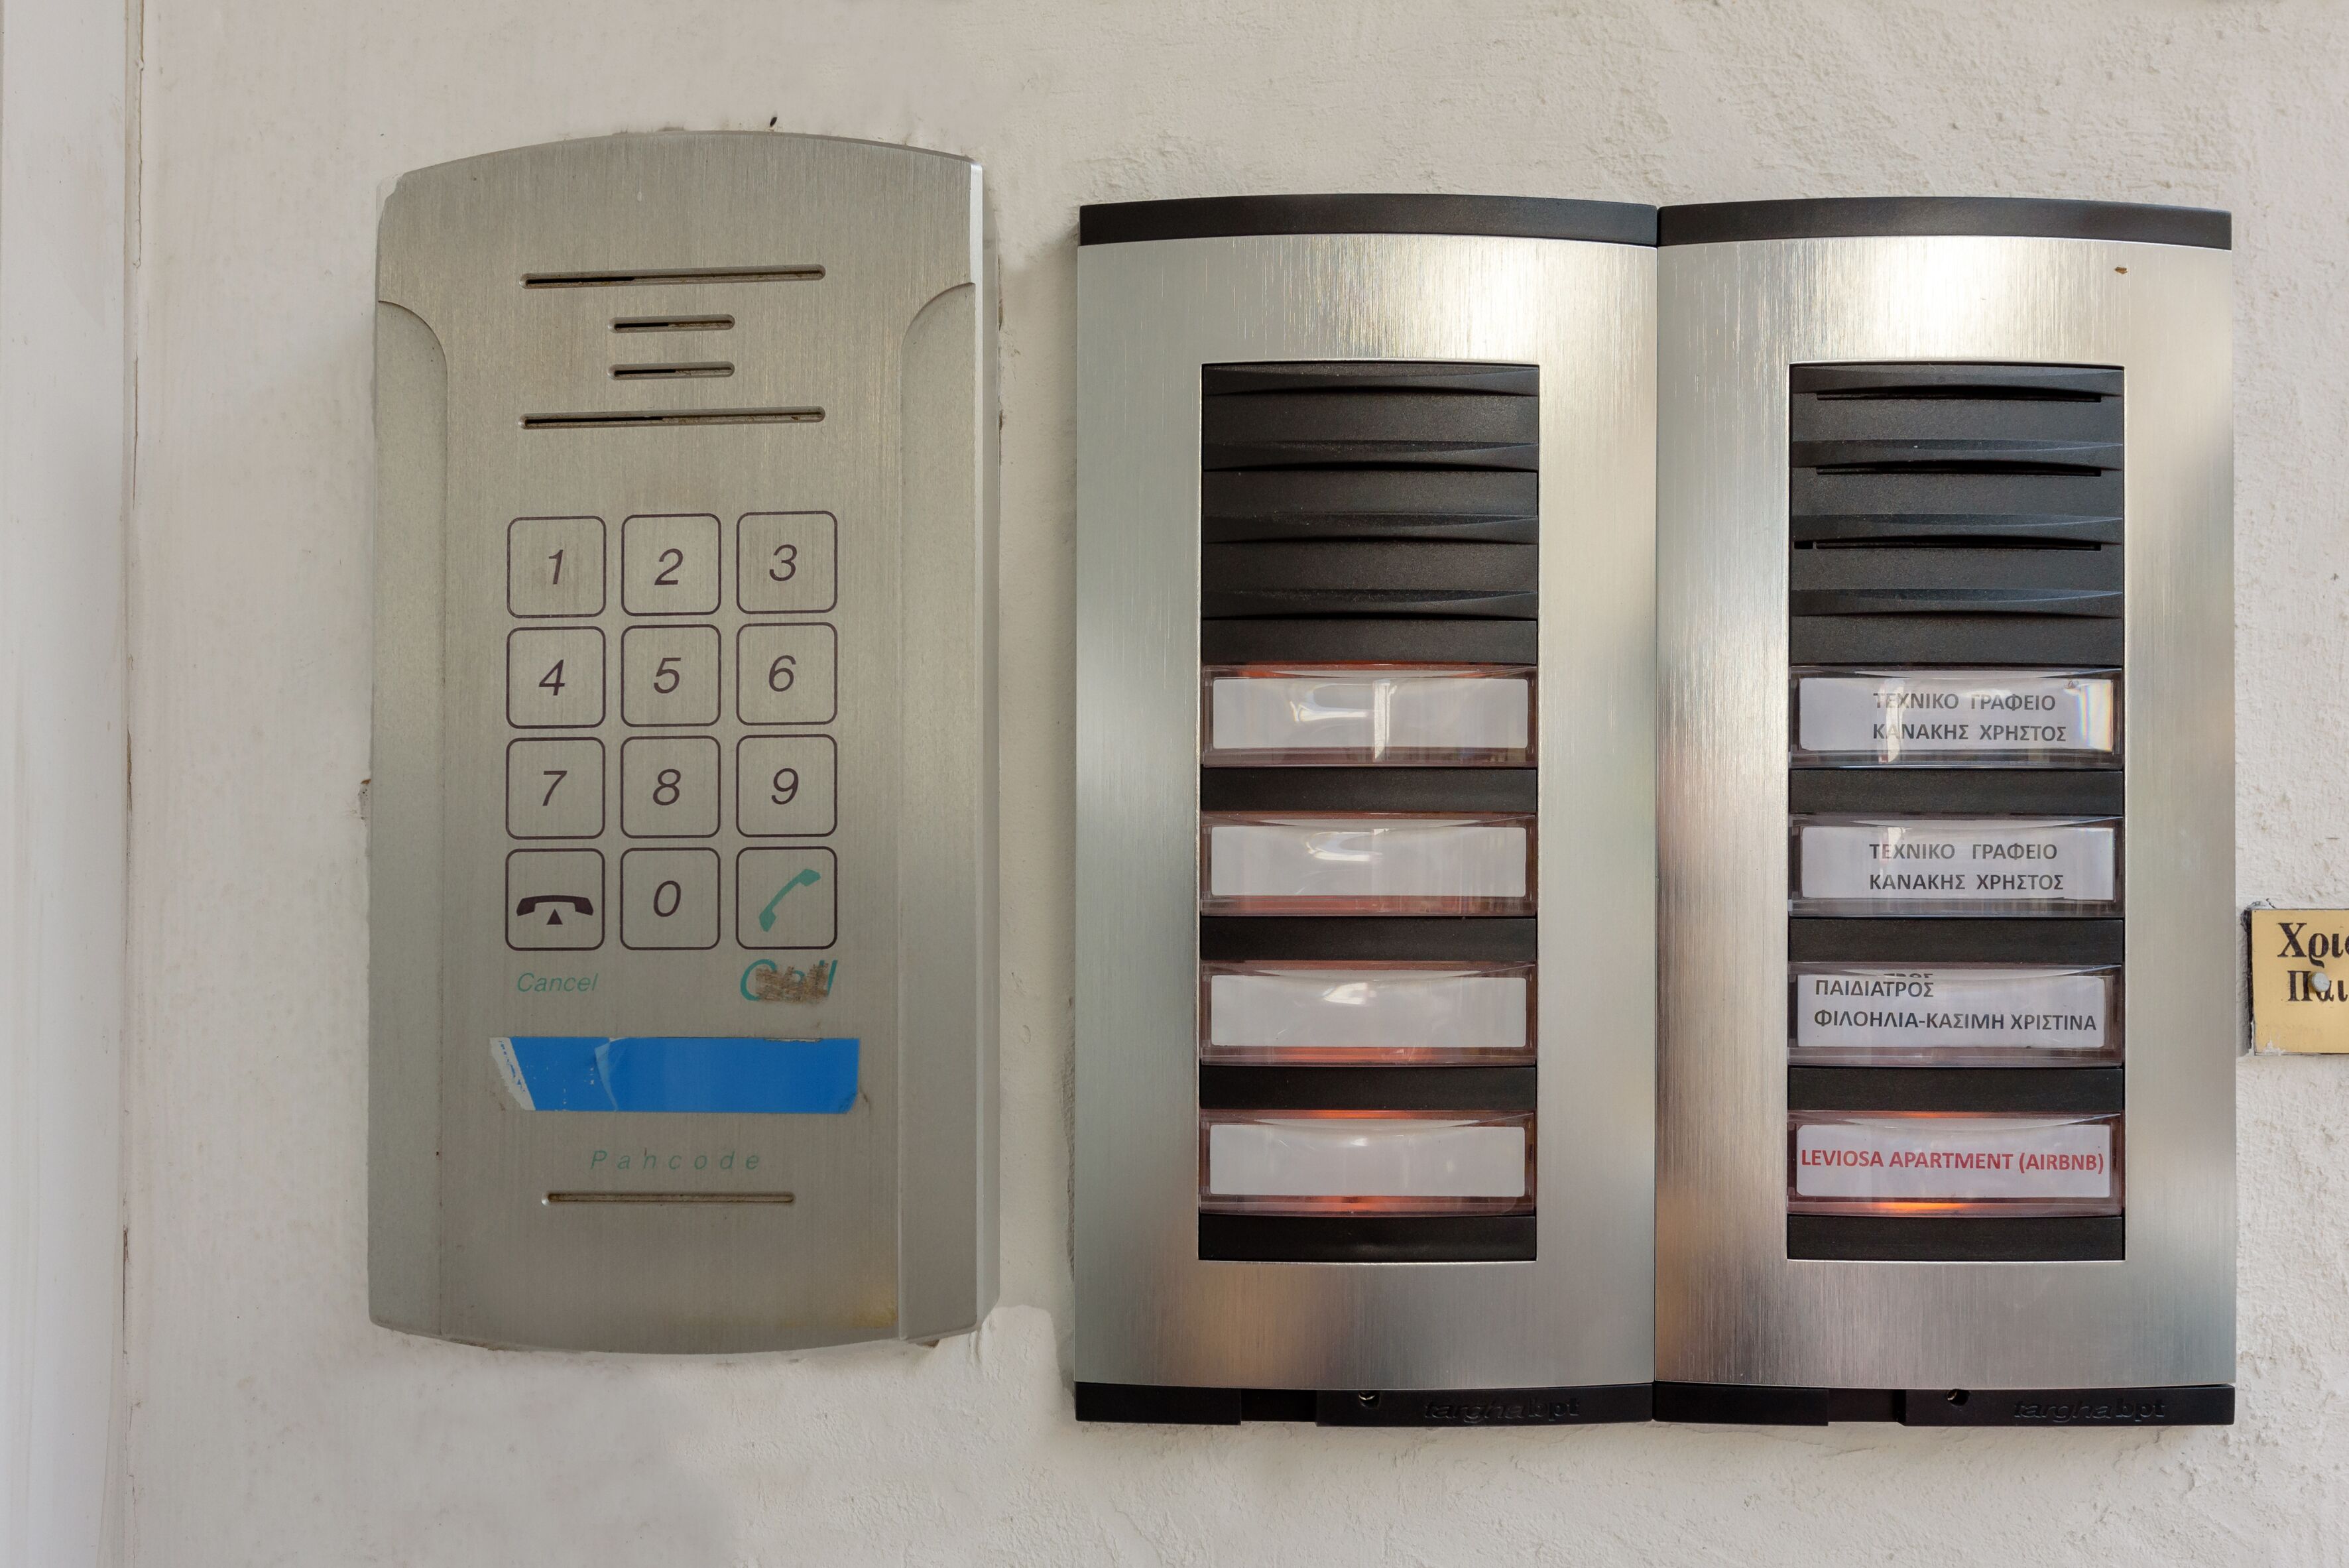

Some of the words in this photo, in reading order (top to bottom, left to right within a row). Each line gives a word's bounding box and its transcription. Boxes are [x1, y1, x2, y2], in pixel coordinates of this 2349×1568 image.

[548, 549, 564, 585] 1
[654, 548, 684, 585] 2
[769, 544, 798, 581] 3
[538, 659, 566, 696] 4
[653, 657, 682, 694] 5
[768, 655, 796, 692] 6
[1873, 693, 1959, 710] ΤΕΧΝΙΚΟ
[1970, 693, 2056, 711] ΓΡΑΦΕΙΟ
[1873, 723, 1969, 740] ΚΑΝΑΚΗΣ
[1980, 724, 2067, 742] ΧΡΗΣΤΟΣ
[542, 770, 568, 806] 7
[652, 768, 682, 806] 8
[771, 768, 799, 805] 9
[1869, 843, 1955, 859] ΤΕΧΝΙΚΟ
[1972, 843, 2057, 861] ΓΡΑΦΕΙΟ
[1870, 874, 1966, 890] ΚΑΝΑΚΗΣ
[1976, 874, 2064, 890] ΧΡΗΣΤΟΣ
[653, 880, 682, 918] 0
[2277, 922, 2349, 968] Χρι
[516, 972, 599, 993] Cancel
[1815, 979, 1934, 998] ΠΑΙΔΙΑΤΡΟΣ
[1814, 1009, 2004, 1030] ΦΙΛΟΗΛΙΑ-ΚΑΣΙΜΗ
[2010, 1014, 2097, 1031] ΧΡΙΣΤΙΝΑ
[1801, 1150, 1884, 1167] LEVIOSA
[1889, 1151, 2014, 1170] APARTMENT
[2019, 1152, 2104, 1174] (AIRBNB)
